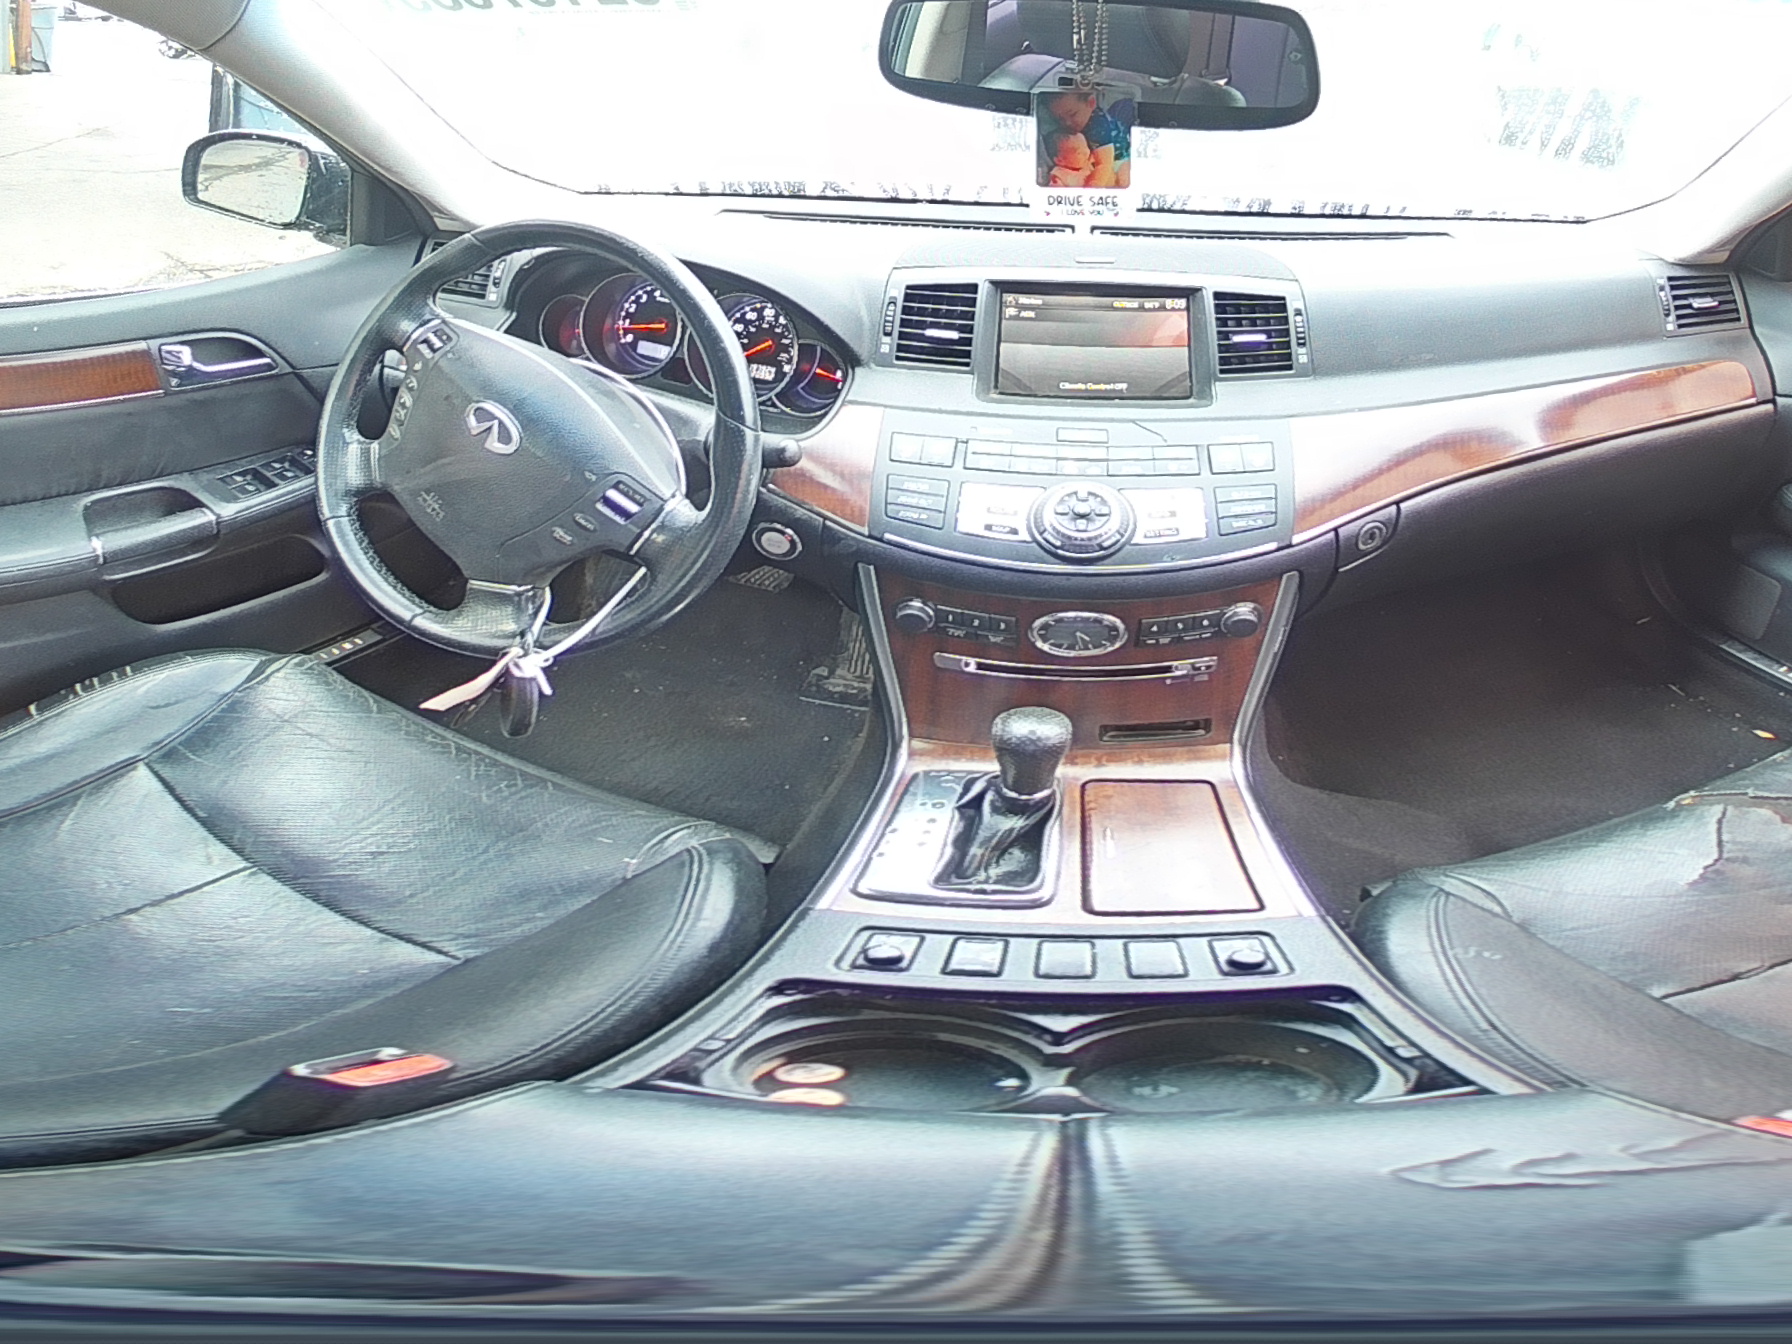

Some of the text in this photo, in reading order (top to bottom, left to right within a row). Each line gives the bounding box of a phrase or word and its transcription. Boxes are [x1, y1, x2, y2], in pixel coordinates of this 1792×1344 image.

[1047, 195, 1119, 208] DRIVE SAFE
[639, 293, 648, 303] 3
[628, 303, 637, 313] 2
[972, 618, 980, 627] 2
[1150, 623, 1159, 632] 4
